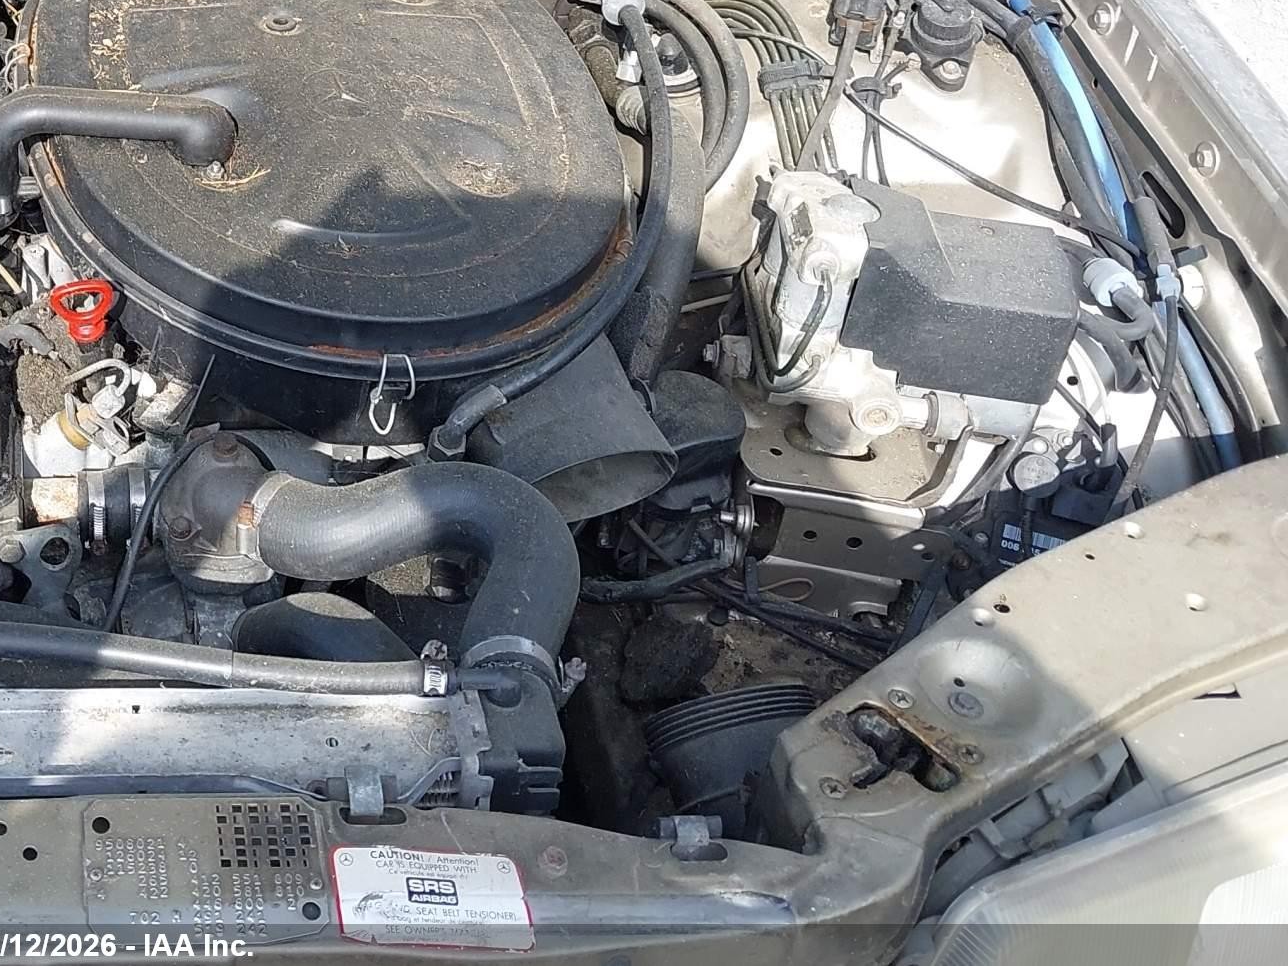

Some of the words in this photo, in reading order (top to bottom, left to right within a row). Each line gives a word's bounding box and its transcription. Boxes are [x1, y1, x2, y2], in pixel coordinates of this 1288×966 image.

[369, 849, 424, 861] CAUTION!
[436, 856, 479, 866] Attention!
[375, 859, 393, 869] CAR
[409, 861, 450, 872] EQUIPPED
[453, 866, 477, 874] WITH
[232, 873, 262, 886] 551
[408, 879, 455, 894] SRS
[233, 885, 263, 898] 581
[235, 897, 264, 911] 600
[287, 897, 296, 911] 2
[410, 893, 457, 905] AIRBAG
[415, 906, 437, 916] SEAT
[443, 908, 460, 917] BELT
[465, 909, 517, 922] TENSIONER)
[385, 924, 401, 934] SEE
